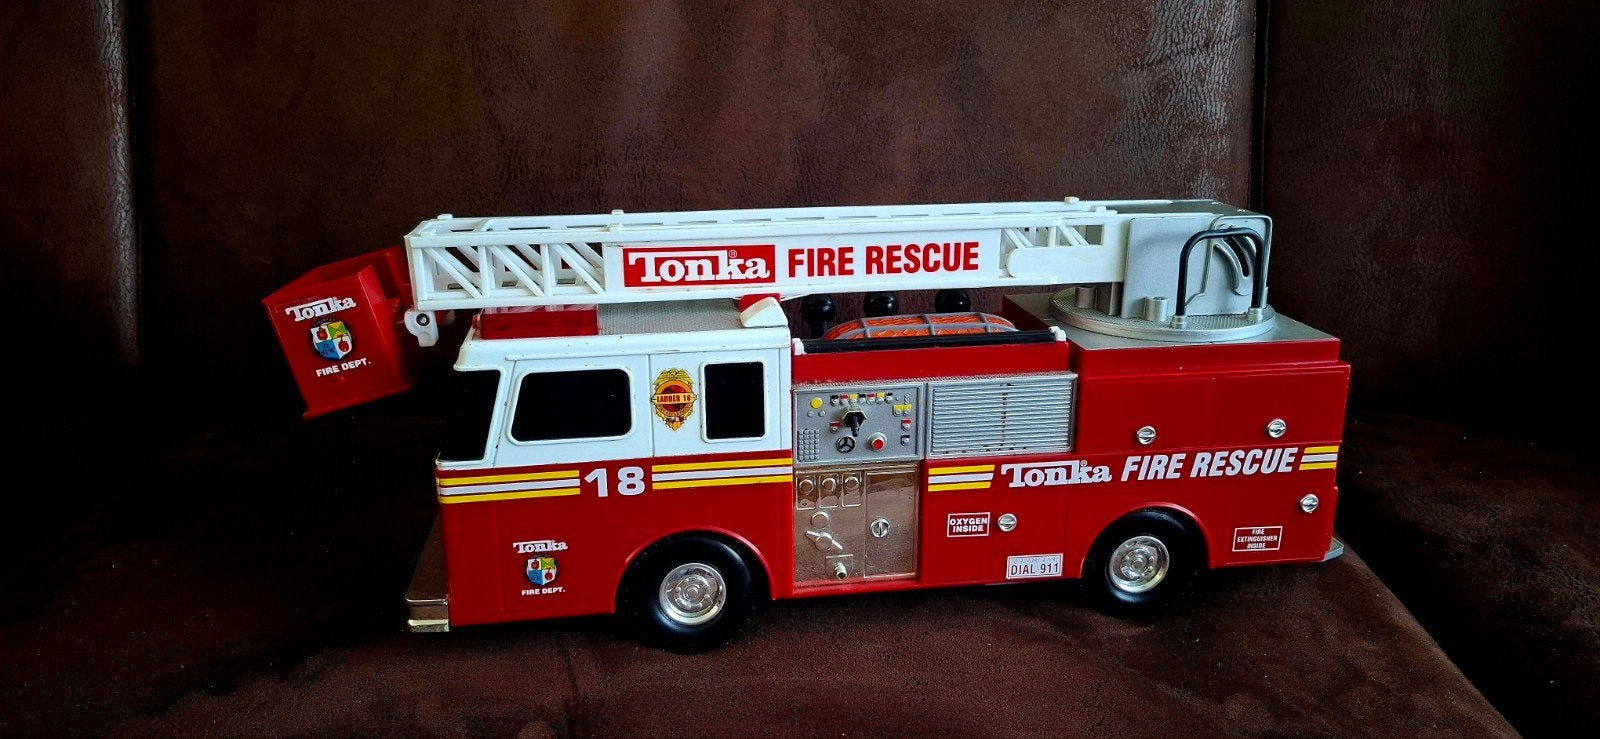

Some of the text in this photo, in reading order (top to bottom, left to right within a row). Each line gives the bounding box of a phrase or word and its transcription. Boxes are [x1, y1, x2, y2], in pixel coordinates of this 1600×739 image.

[788, 247, 854, 278] FIRE
[865, 242, 979, 275] RESCUE
[285, 297, 356, 322] Tonka
[316, 358, 371, 377] FIRE DEPT.
[683, 394, 691, 402] 18
[1121, 454, 1186, 482] FIRE
[1190, 448, 1298, 478] RESCUE
[584, 466, 645, 497] 18
[949, 517, 988, 525] OXYGEN
[512, 540, 568, 553] Tonka
[1010, 562, 1059, 576] DIAL 911
[541, 586, 566, 594] DEPT.
